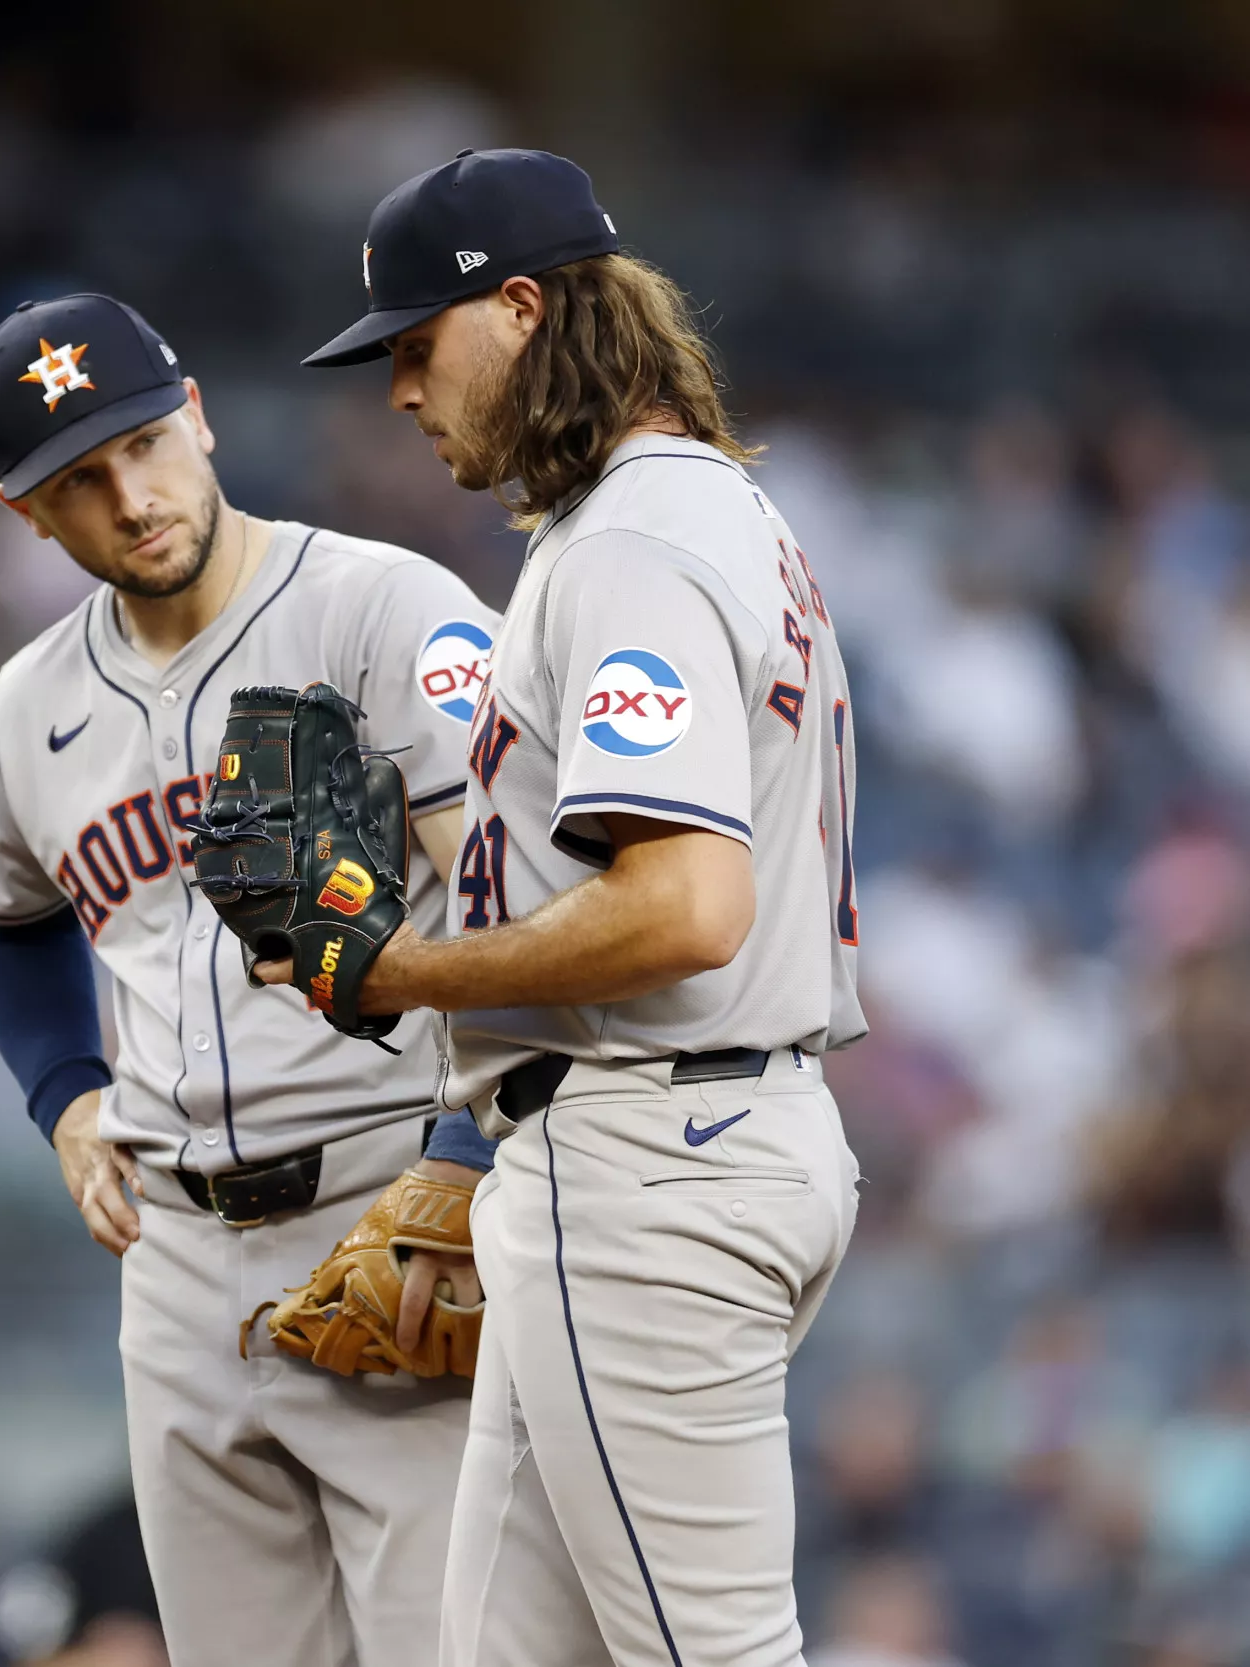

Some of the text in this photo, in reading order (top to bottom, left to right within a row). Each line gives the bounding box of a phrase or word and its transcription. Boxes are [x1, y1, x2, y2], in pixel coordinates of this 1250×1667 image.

[27, 343, 89, 404] H
[421, 657, 492, 697] OX
[583, 690, 688, 720] OXY
[57, 772, 217, 947] HOUS
[317, 829, 332, 861] SZA
[458, 812, 512, 931] 41
